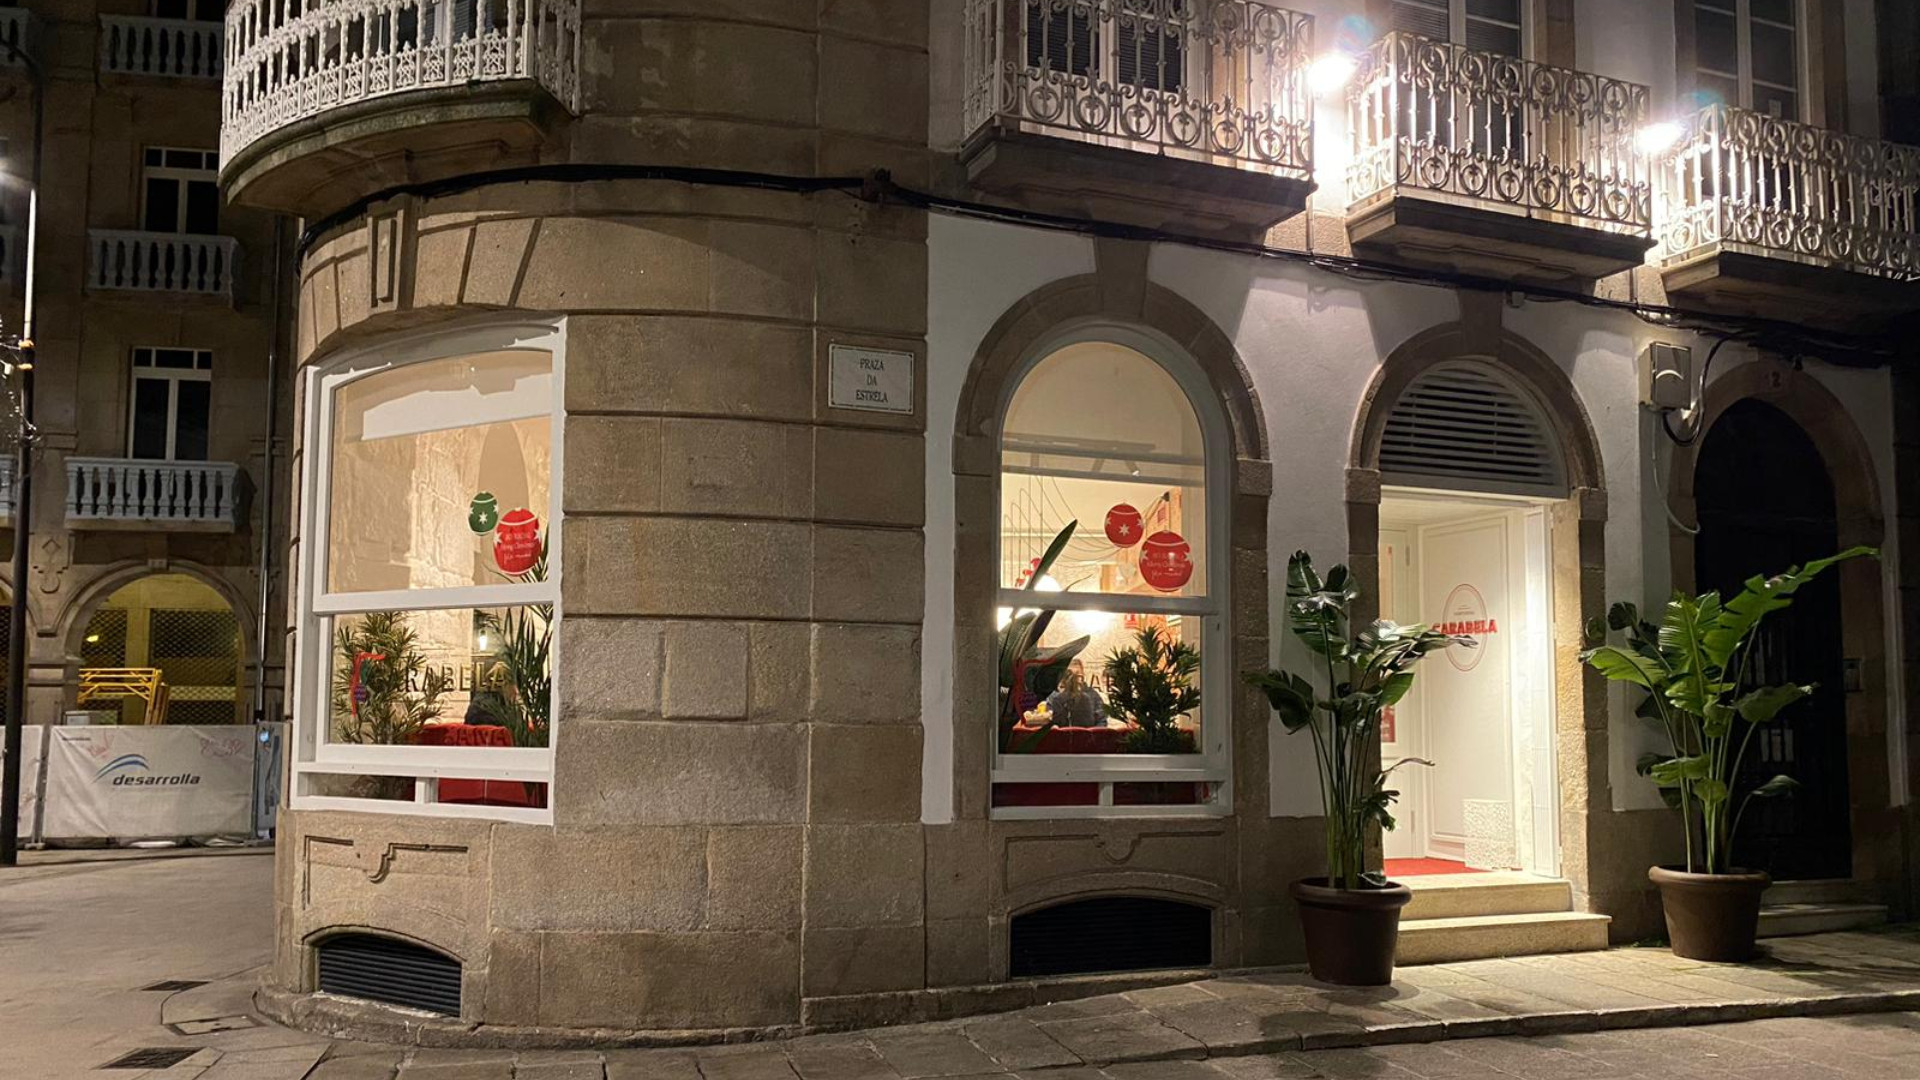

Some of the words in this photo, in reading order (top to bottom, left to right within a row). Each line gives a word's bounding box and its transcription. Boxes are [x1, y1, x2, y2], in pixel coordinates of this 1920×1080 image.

[860, 358, 884, 370] PRAZA
[867, 374, 877, 386] DA
[856, 389, 889, 403] ESTRELA
[399, 661, 508, 693] RABELA
[112, 773, 201, 786] desarrolla
